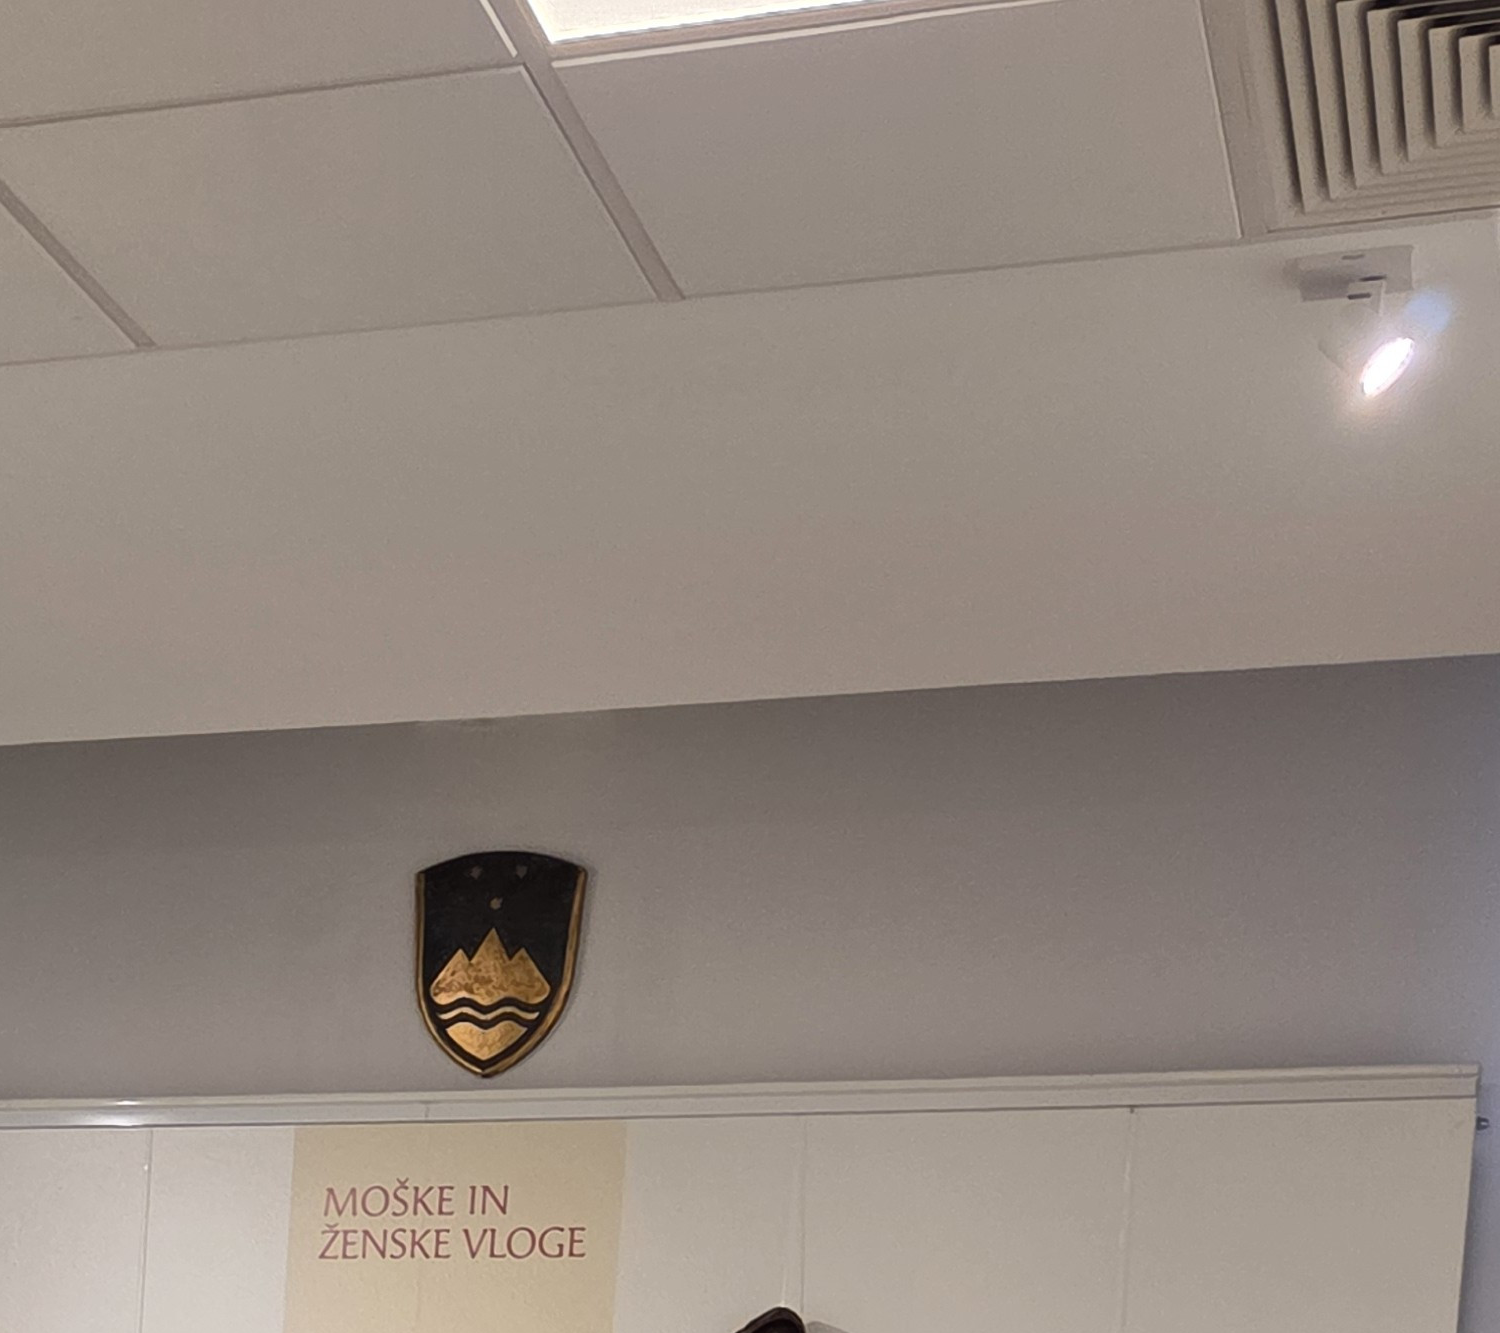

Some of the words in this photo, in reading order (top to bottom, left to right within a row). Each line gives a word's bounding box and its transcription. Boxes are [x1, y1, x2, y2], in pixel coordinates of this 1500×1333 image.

[323, 1177, 455, 1217] MOŠKE
[469, 1185, 509, 1215] IN
[318, 1223, 451, 1260] ŽENSKE
[462, 1226, 586, 1259] VLOGE
